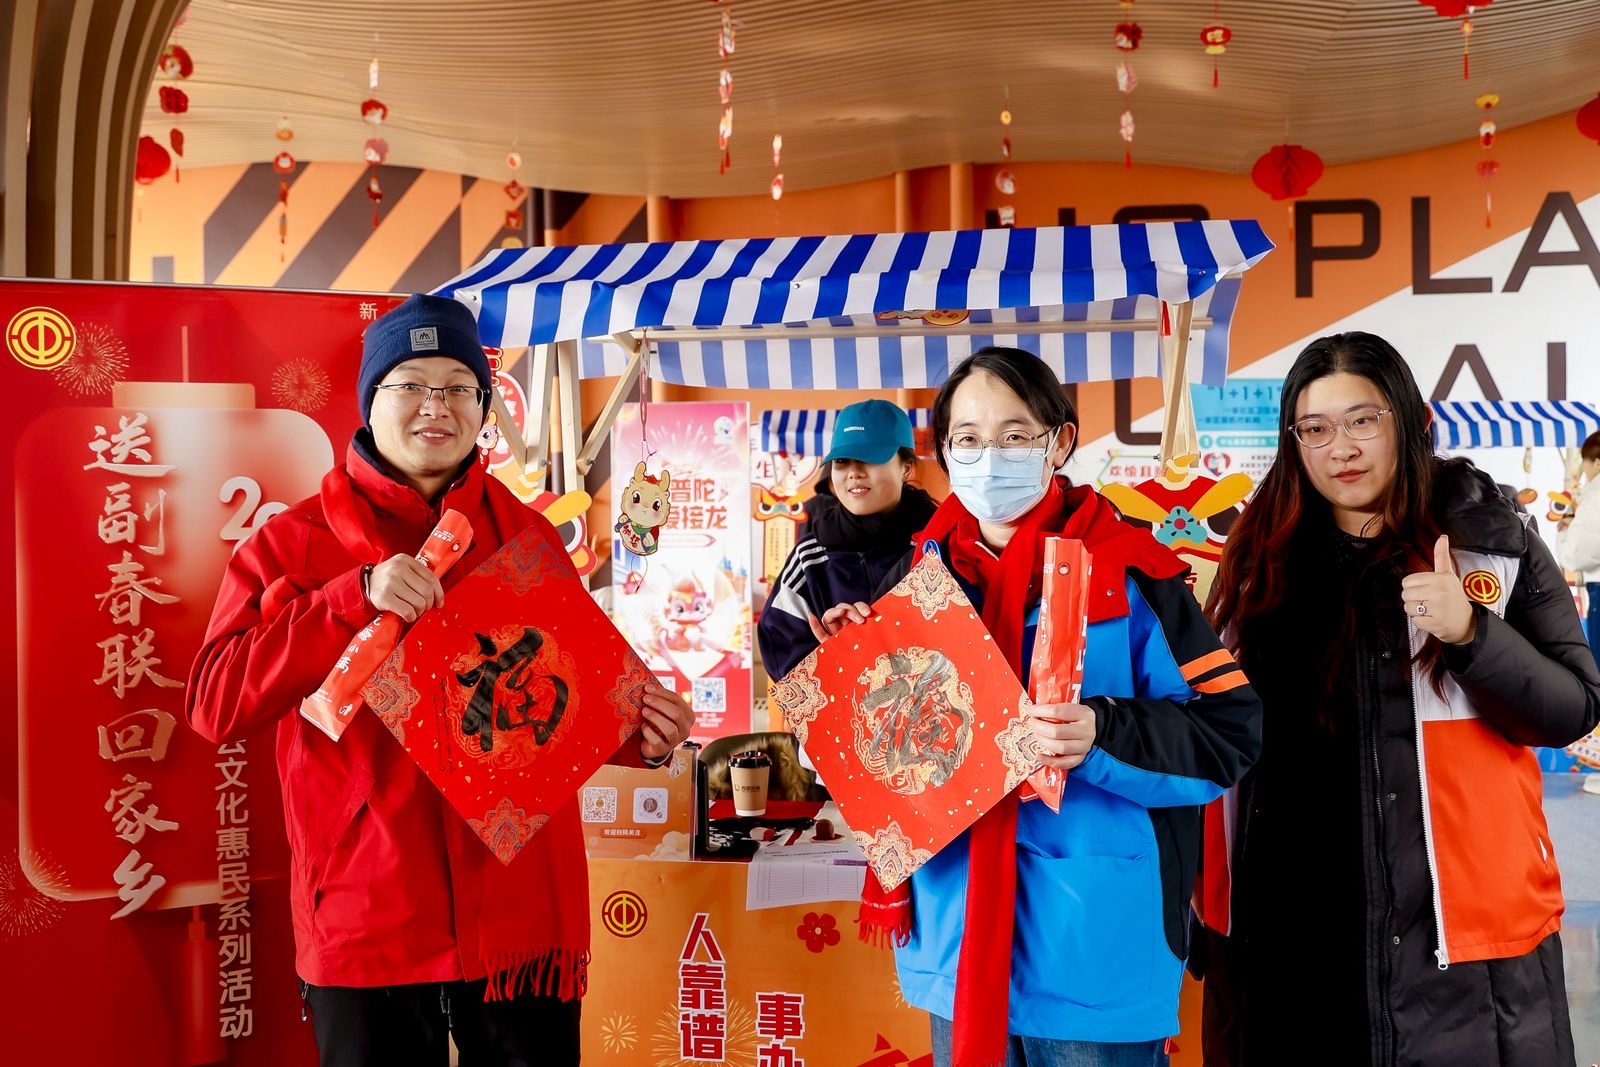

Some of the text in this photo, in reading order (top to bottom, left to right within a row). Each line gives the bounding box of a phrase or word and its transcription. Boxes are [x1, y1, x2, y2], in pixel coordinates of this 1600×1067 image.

[83, 412, 185, 920] 送副春联回家乡
[456, 627, 569, 752] 福
[678, 912, 727, 1063] 人靠谱
